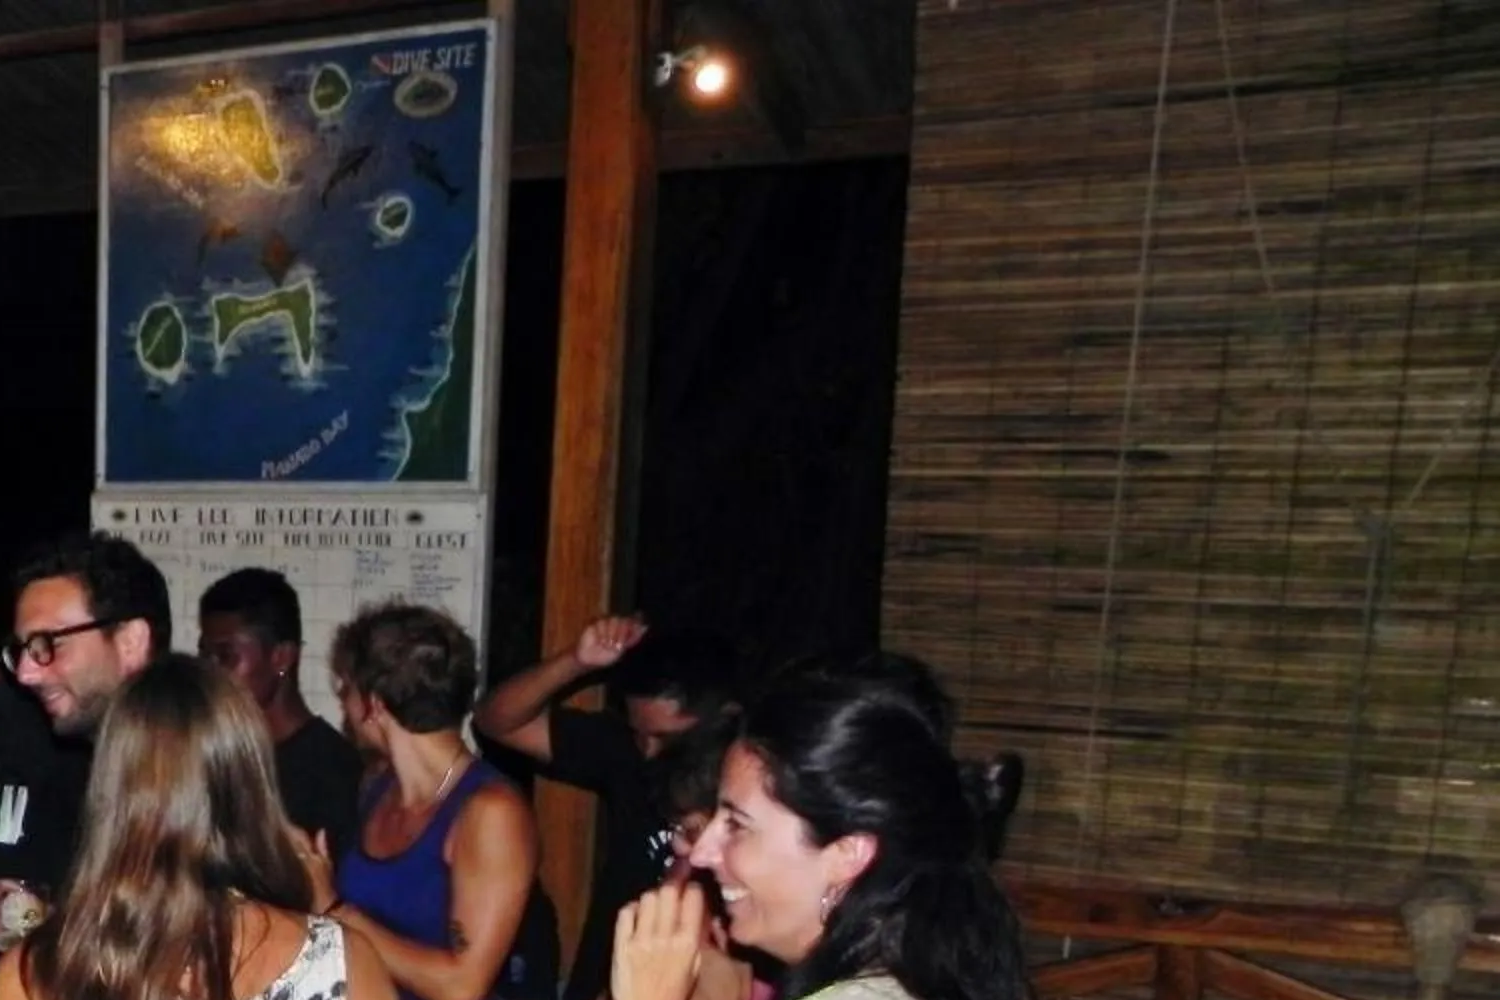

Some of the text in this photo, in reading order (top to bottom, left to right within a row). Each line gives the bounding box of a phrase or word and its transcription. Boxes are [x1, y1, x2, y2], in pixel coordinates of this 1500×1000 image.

[393, 43, 477, 75] DIVE SITE
[254, 507, 398, 527] INFORMATION
